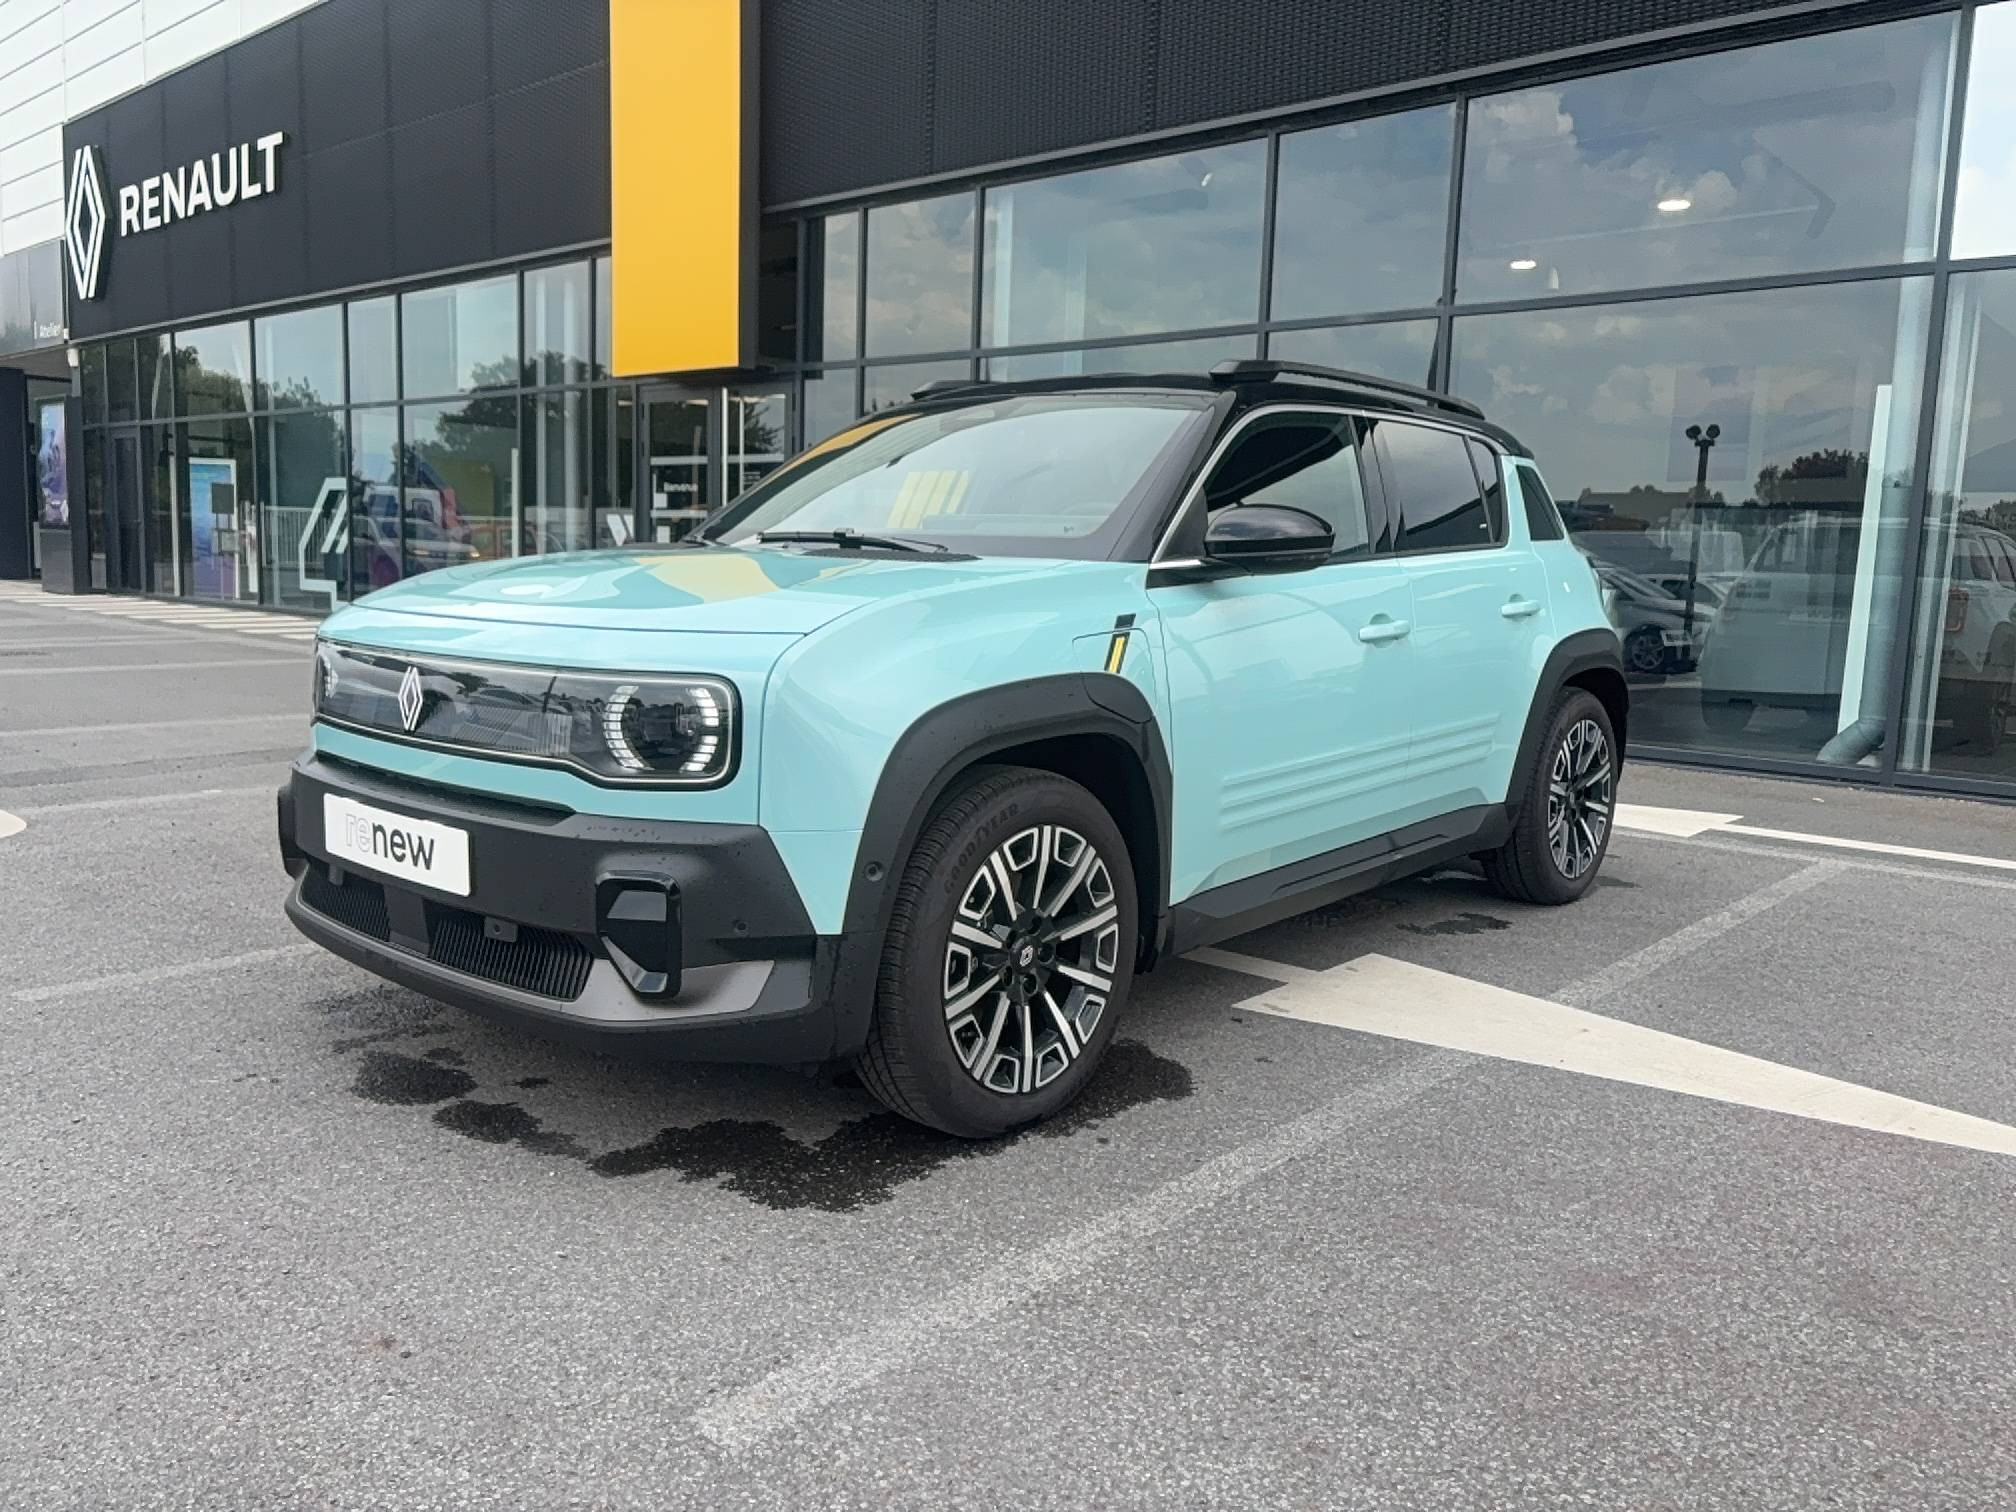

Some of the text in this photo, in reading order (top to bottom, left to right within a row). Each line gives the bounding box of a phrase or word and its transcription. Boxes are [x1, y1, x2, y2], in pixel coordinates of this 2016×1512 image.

[119, 131, 284, 237] RENAULT
[345, 813, 435, 871] renew
[943, 802, 1019, 894] GOODYEAR
